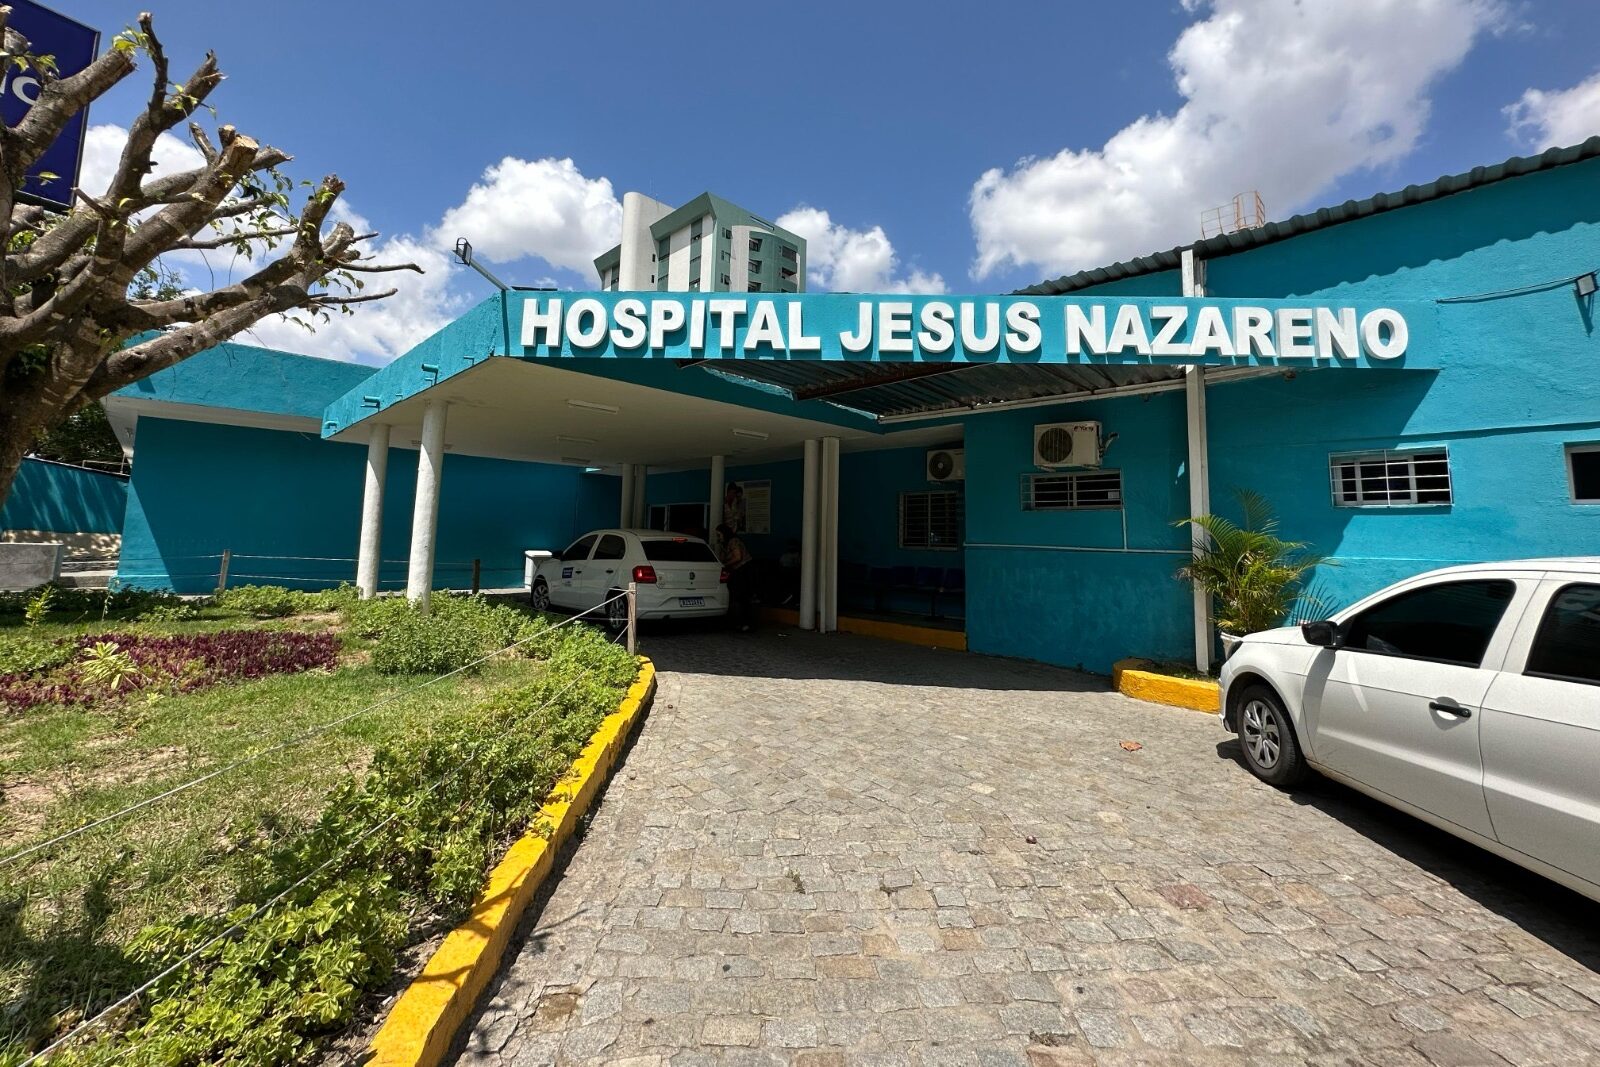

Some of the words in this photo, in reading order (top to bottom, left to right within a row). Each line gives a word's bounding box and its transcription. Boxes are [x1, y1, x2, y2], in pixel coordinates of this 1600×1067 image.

[520, 298, 821, 350] HOSPITAL
[839, 302, 1042, 354] JESUS
[1064, 305, 1409, 361] NAZARENO
